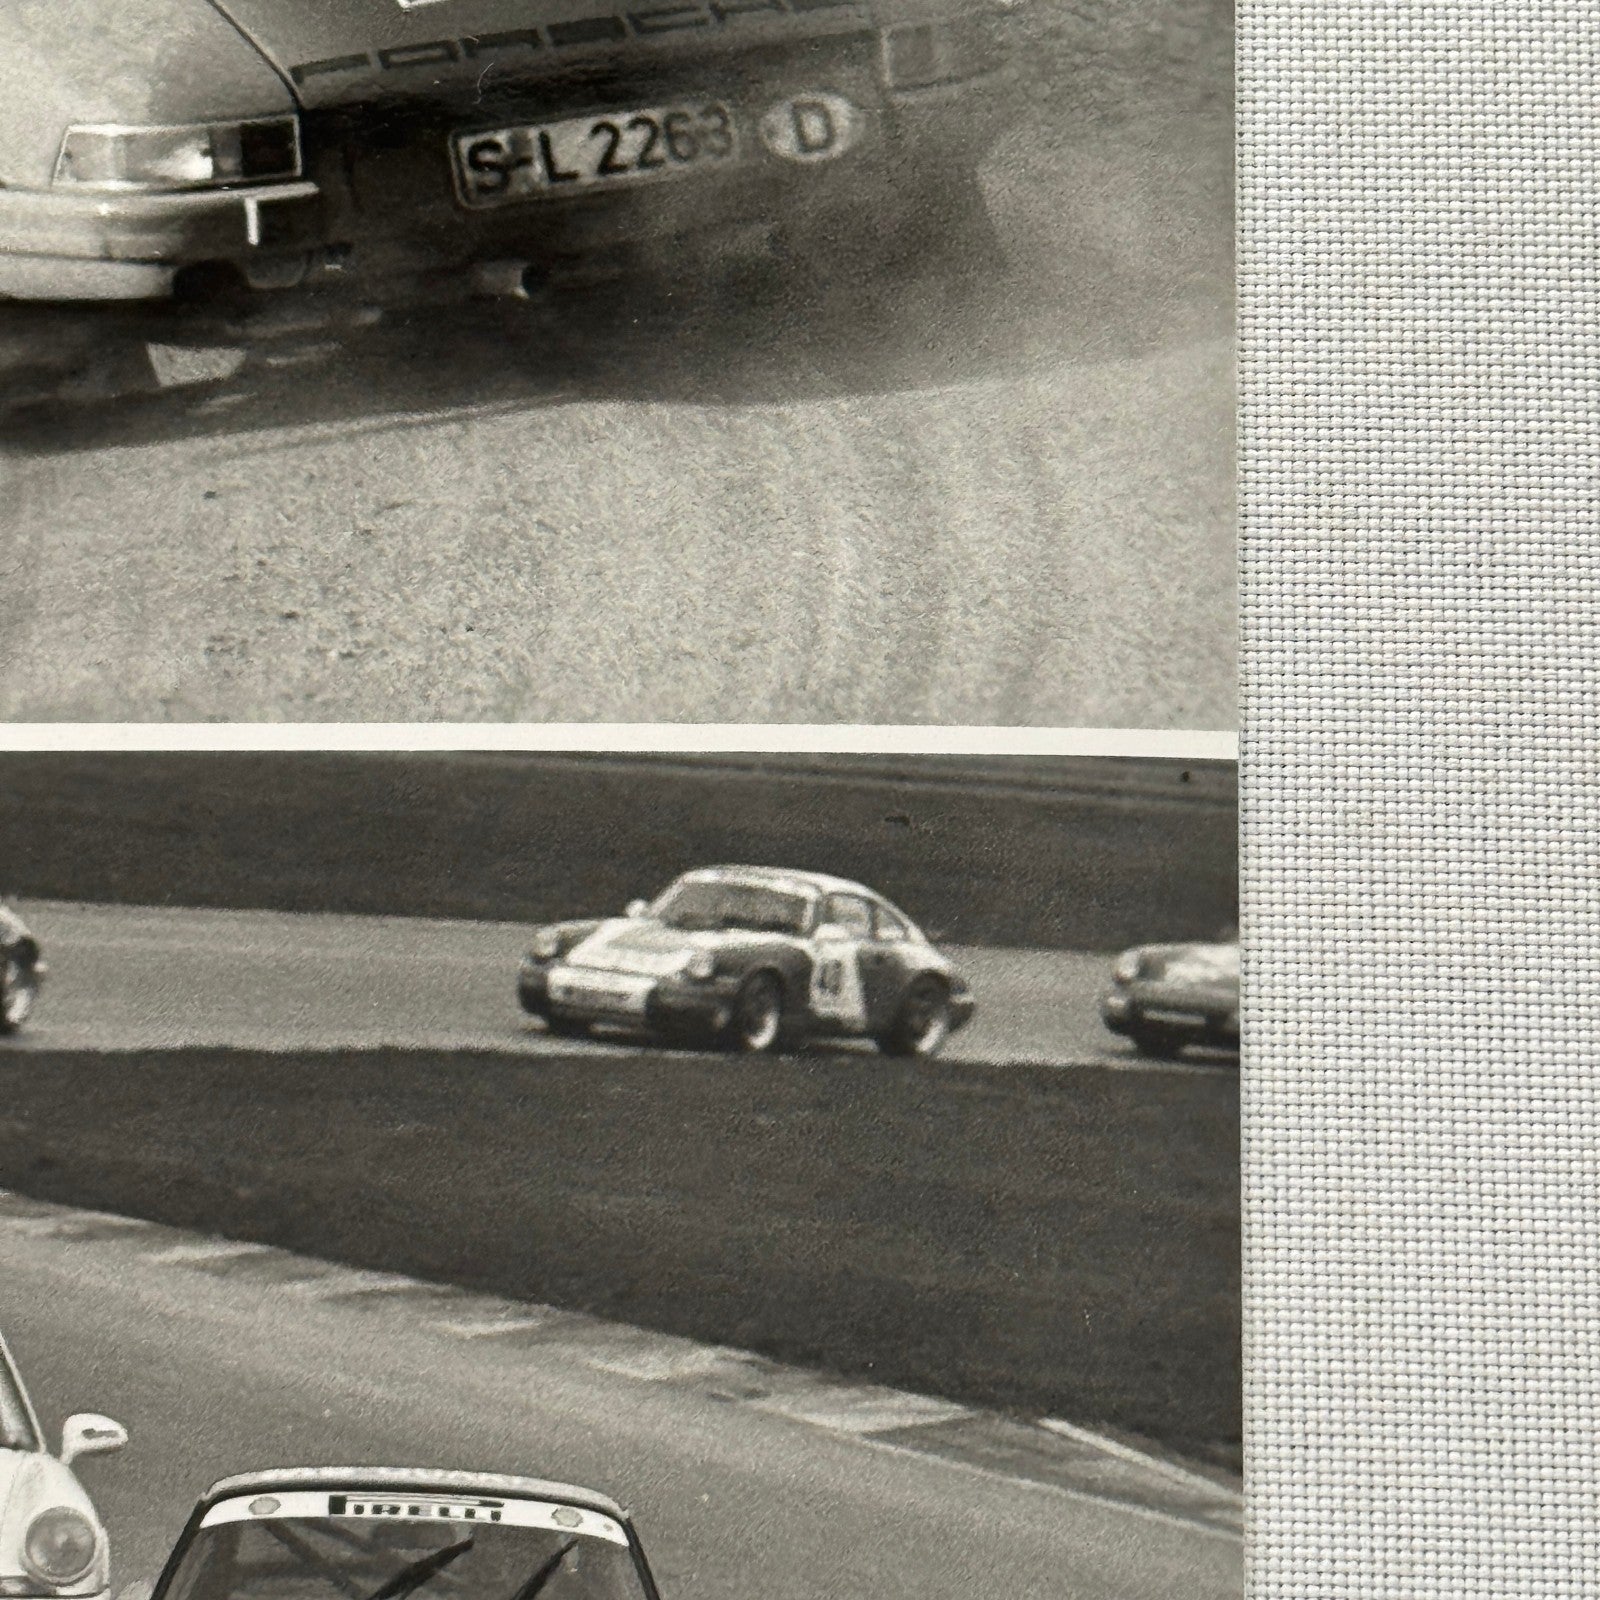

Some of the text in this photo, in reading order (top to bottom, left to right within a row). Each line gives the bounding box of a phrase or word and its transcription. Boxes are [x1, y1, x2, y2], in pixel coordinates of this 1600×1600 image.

[468, 104, 735, 196] S-L 2263
[791, 101, 835, 153] D
